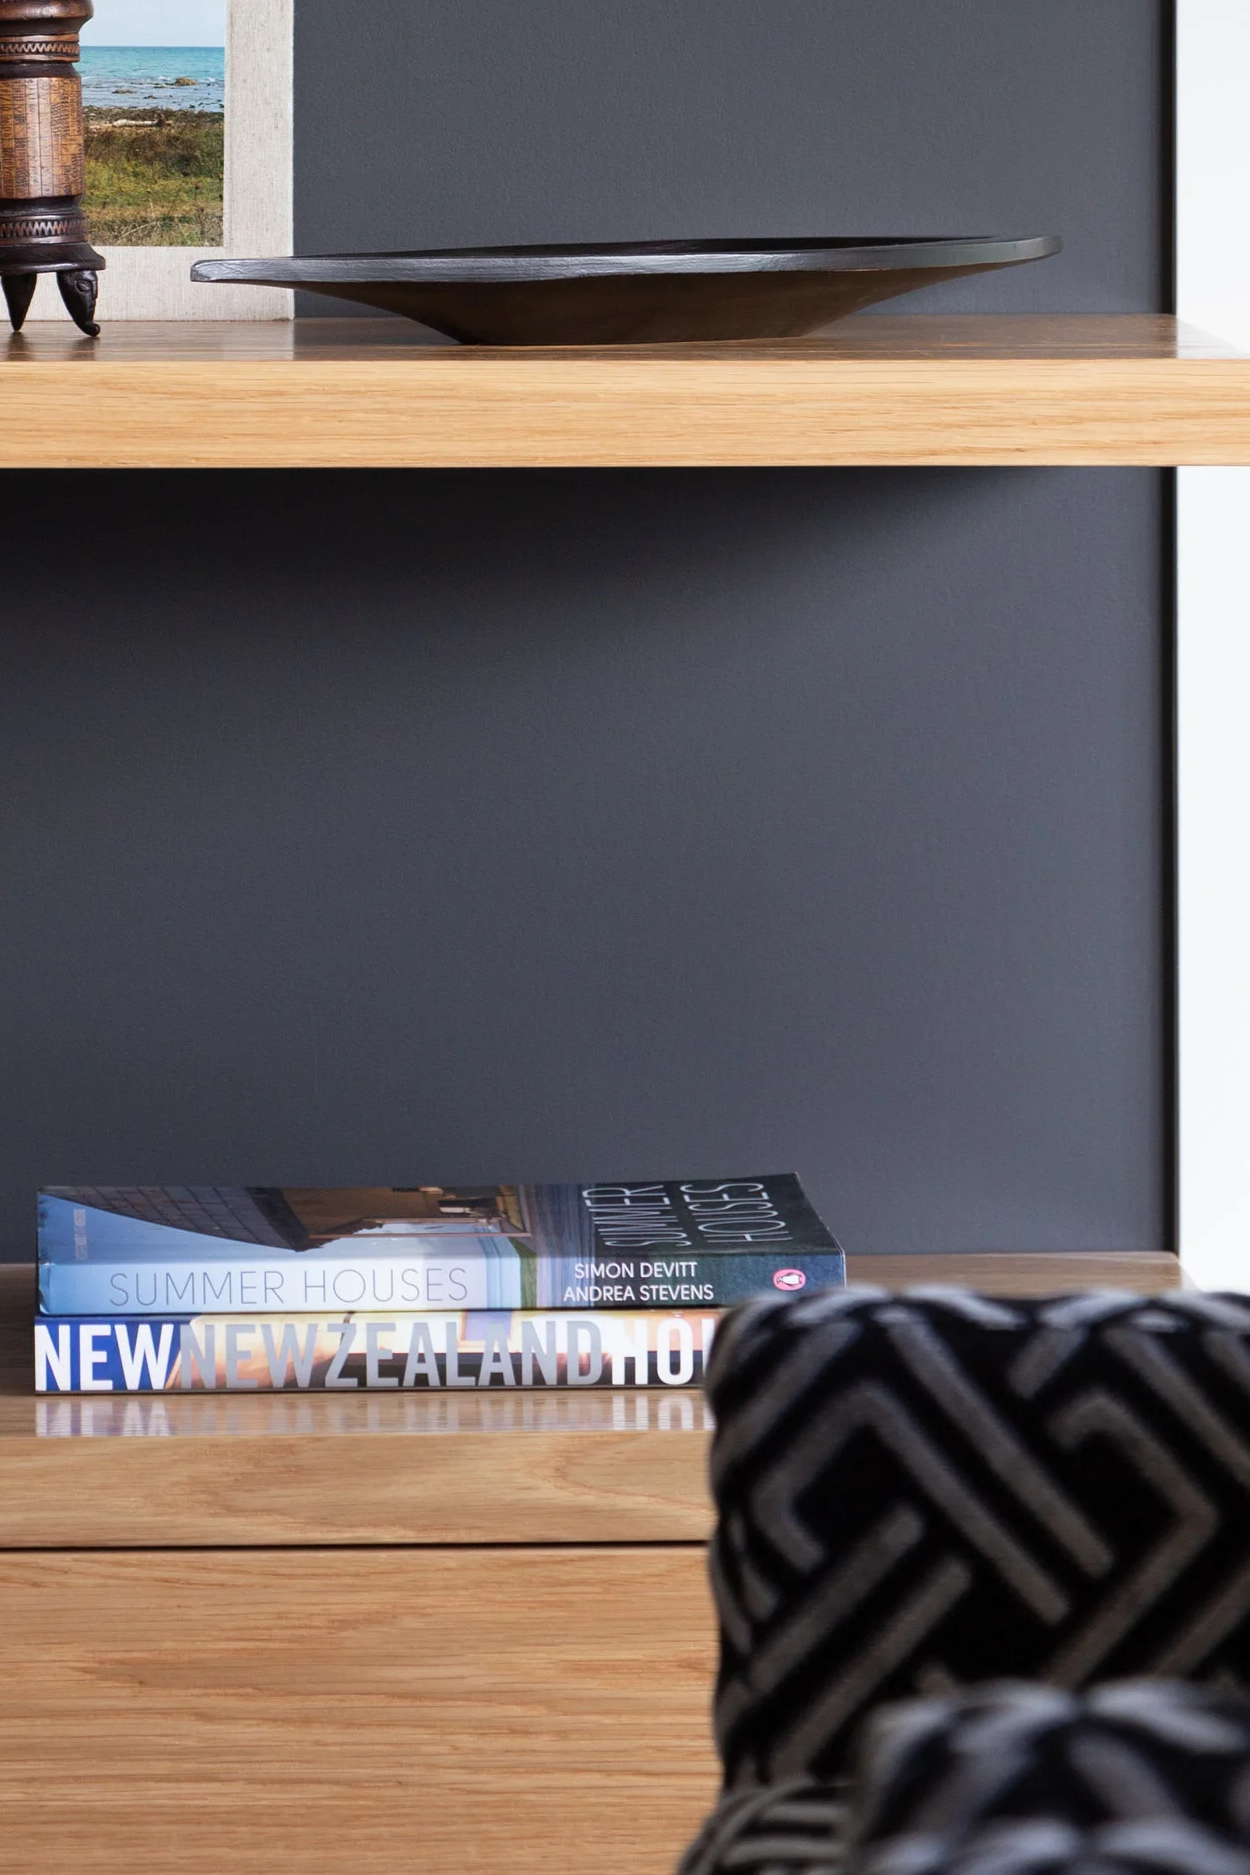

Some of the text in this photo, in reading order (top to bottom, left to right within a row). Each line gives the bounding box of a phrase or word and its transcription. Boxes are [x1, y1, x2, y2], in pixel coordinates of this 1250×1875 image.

[581, 1184, 692, 1247] SUMMER
[679, 1182, 794, 1243] HOUSES
[109, 1268, 469, 1307] SUMMER HOUSES
[573, 1261, 698, 1279] SIMON DEVITT
[563, 1284, 715, 1302] ANDREA STEVENS
